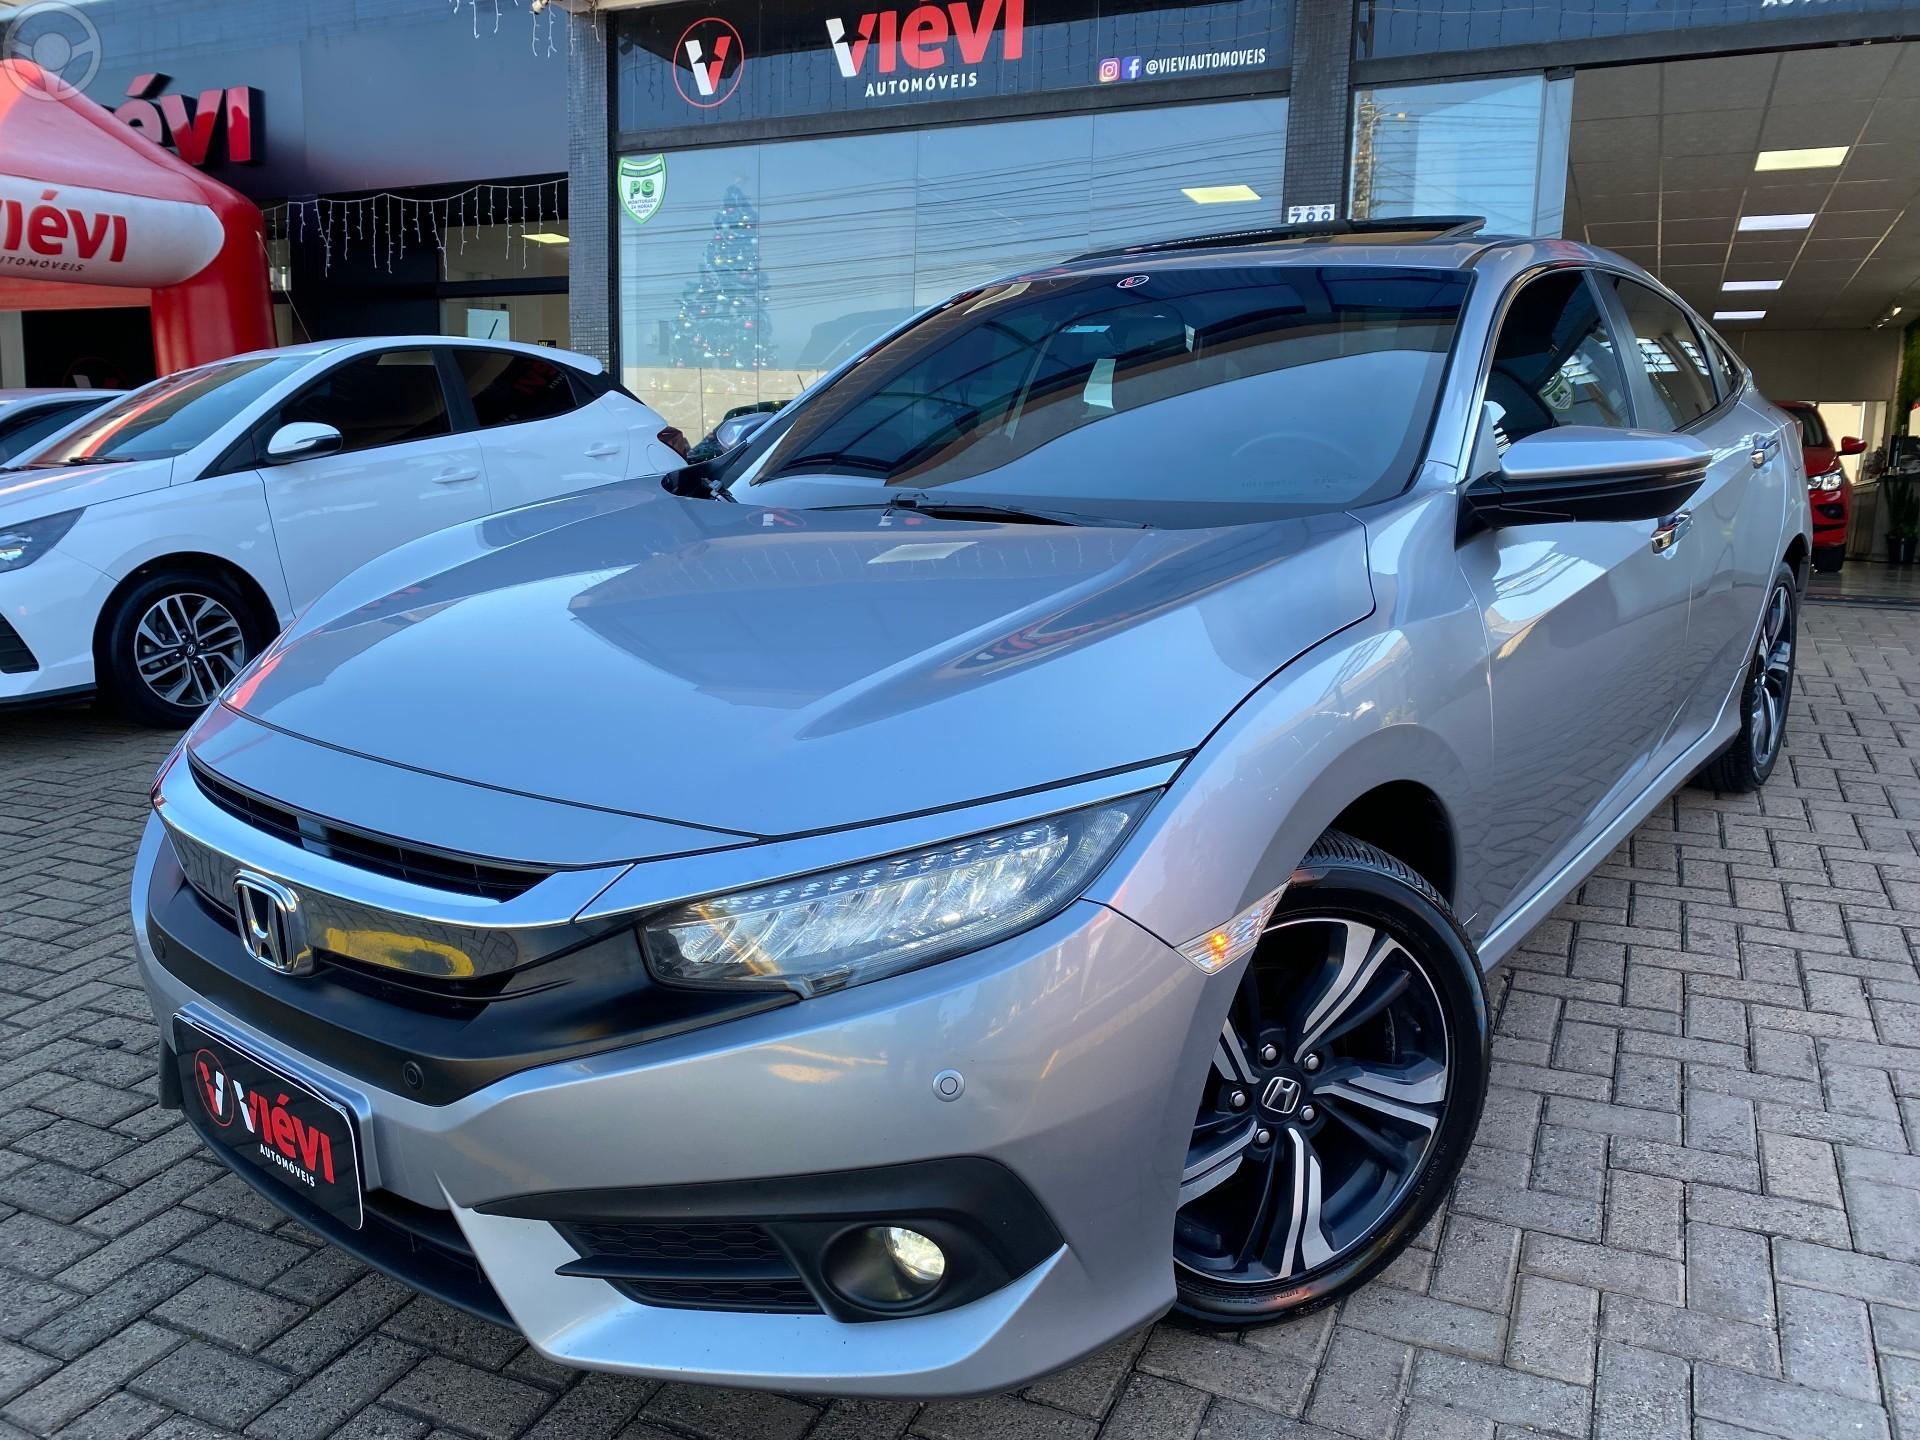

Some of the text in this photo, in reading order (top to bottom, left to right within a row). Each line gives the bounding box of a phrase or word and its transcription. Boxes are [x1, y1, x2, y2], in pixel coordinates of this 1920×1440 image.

[1145, 48, 1266, 75] @VIEVIAUTOMOVEIS
[864, 72, 978, 98] AUTOMÓVEIS
[259, 1143, 316, 1188] AUTOMÓVEIS
